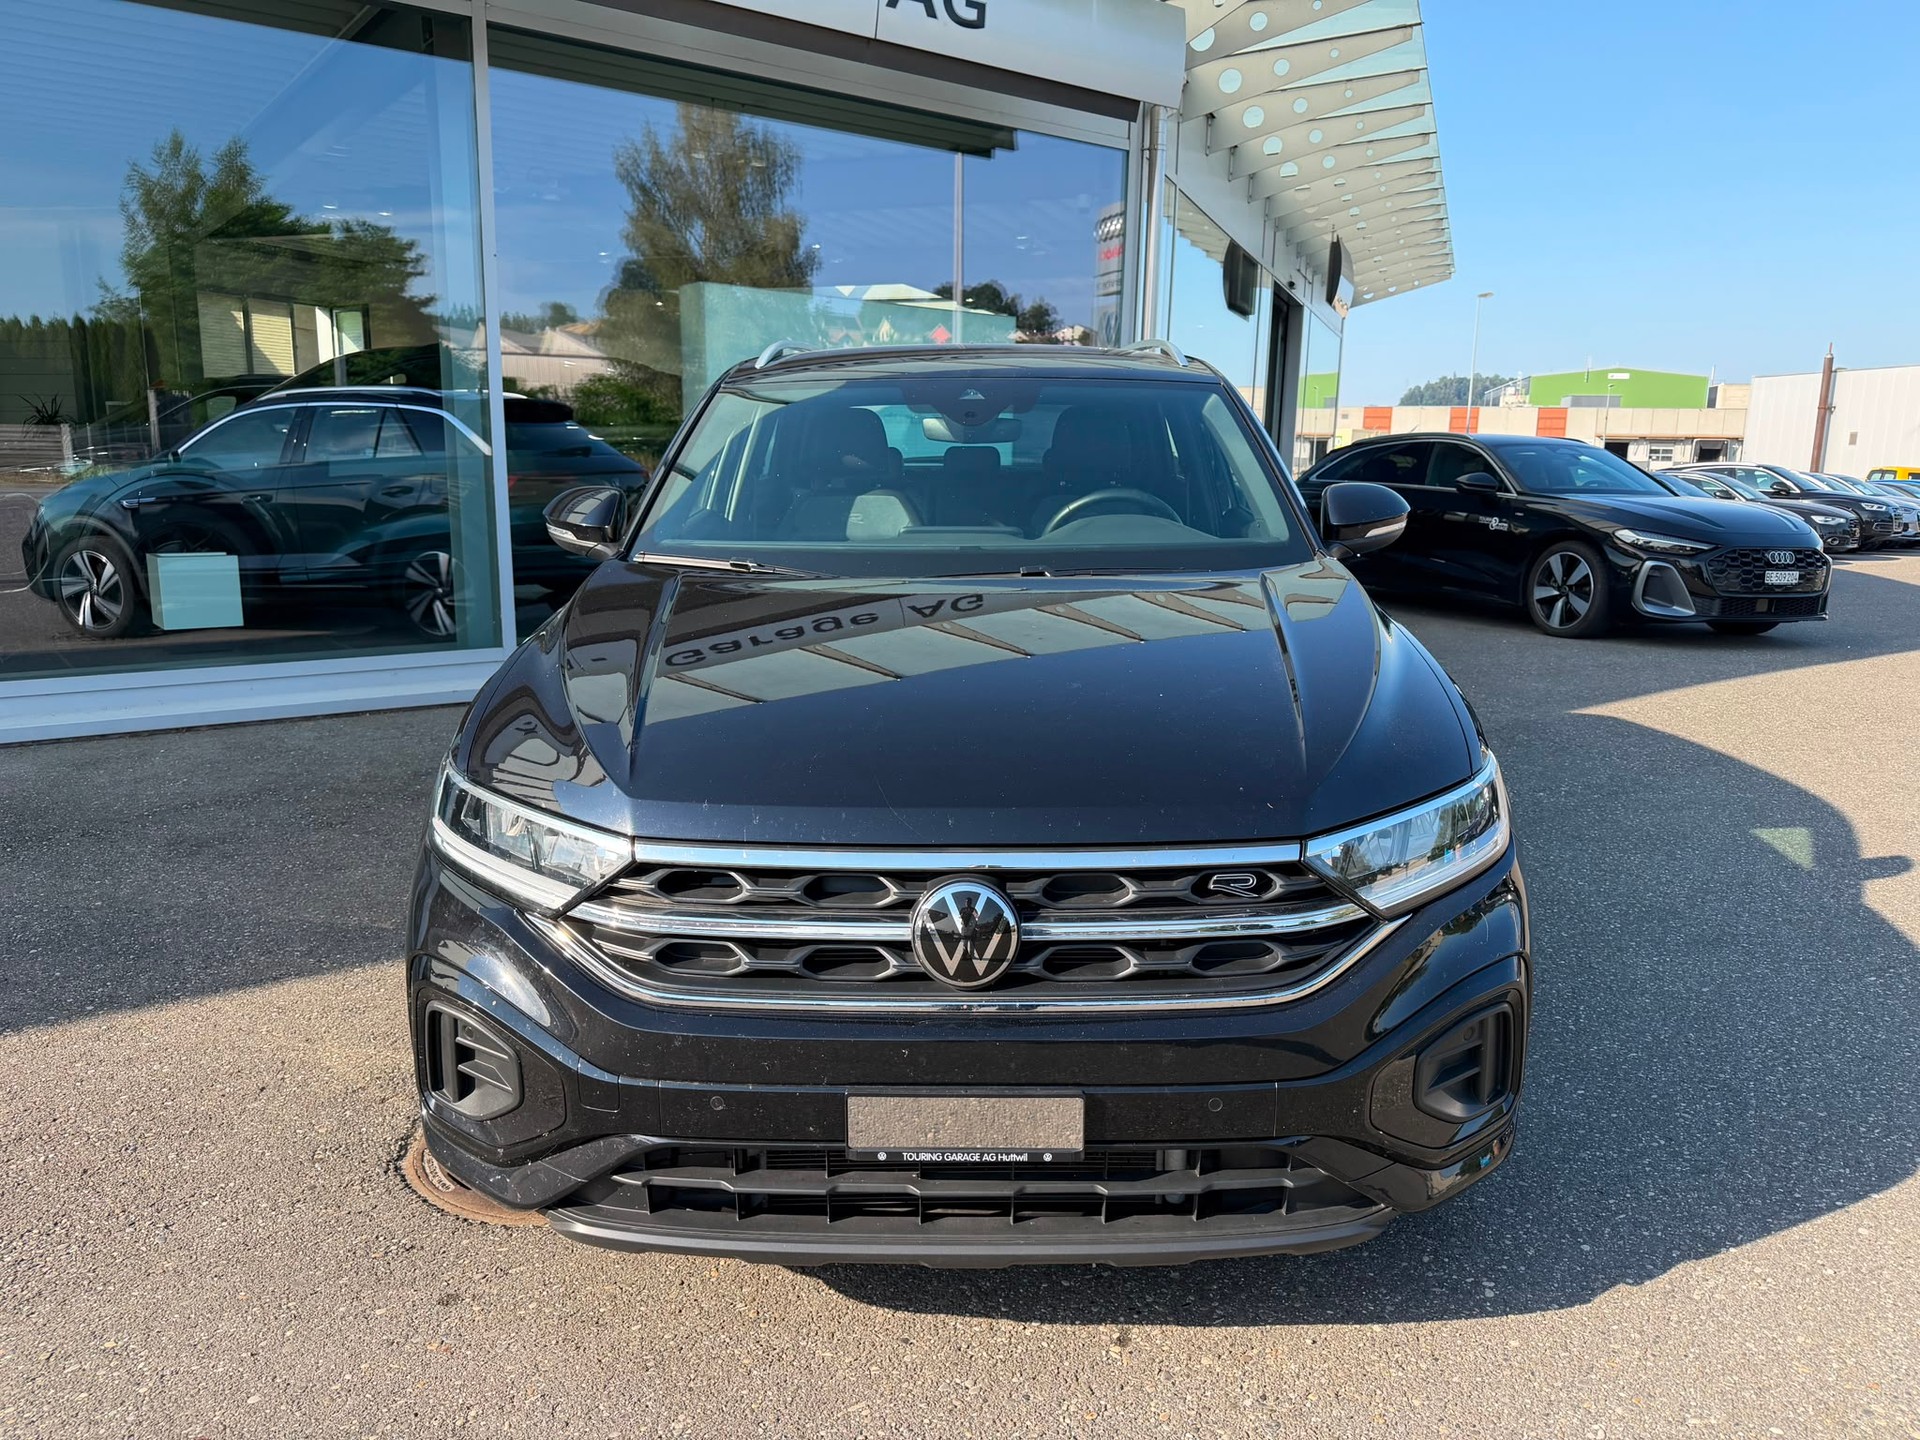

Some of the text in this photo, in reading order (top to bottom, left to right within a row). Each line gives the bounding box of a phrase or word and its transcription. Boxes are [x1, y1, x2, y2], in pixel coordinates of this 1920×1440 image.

[1208, 873, 1259, 898] R
[902, 1152, 1028, 1162] TOURING GARAGE AG Huttwil
